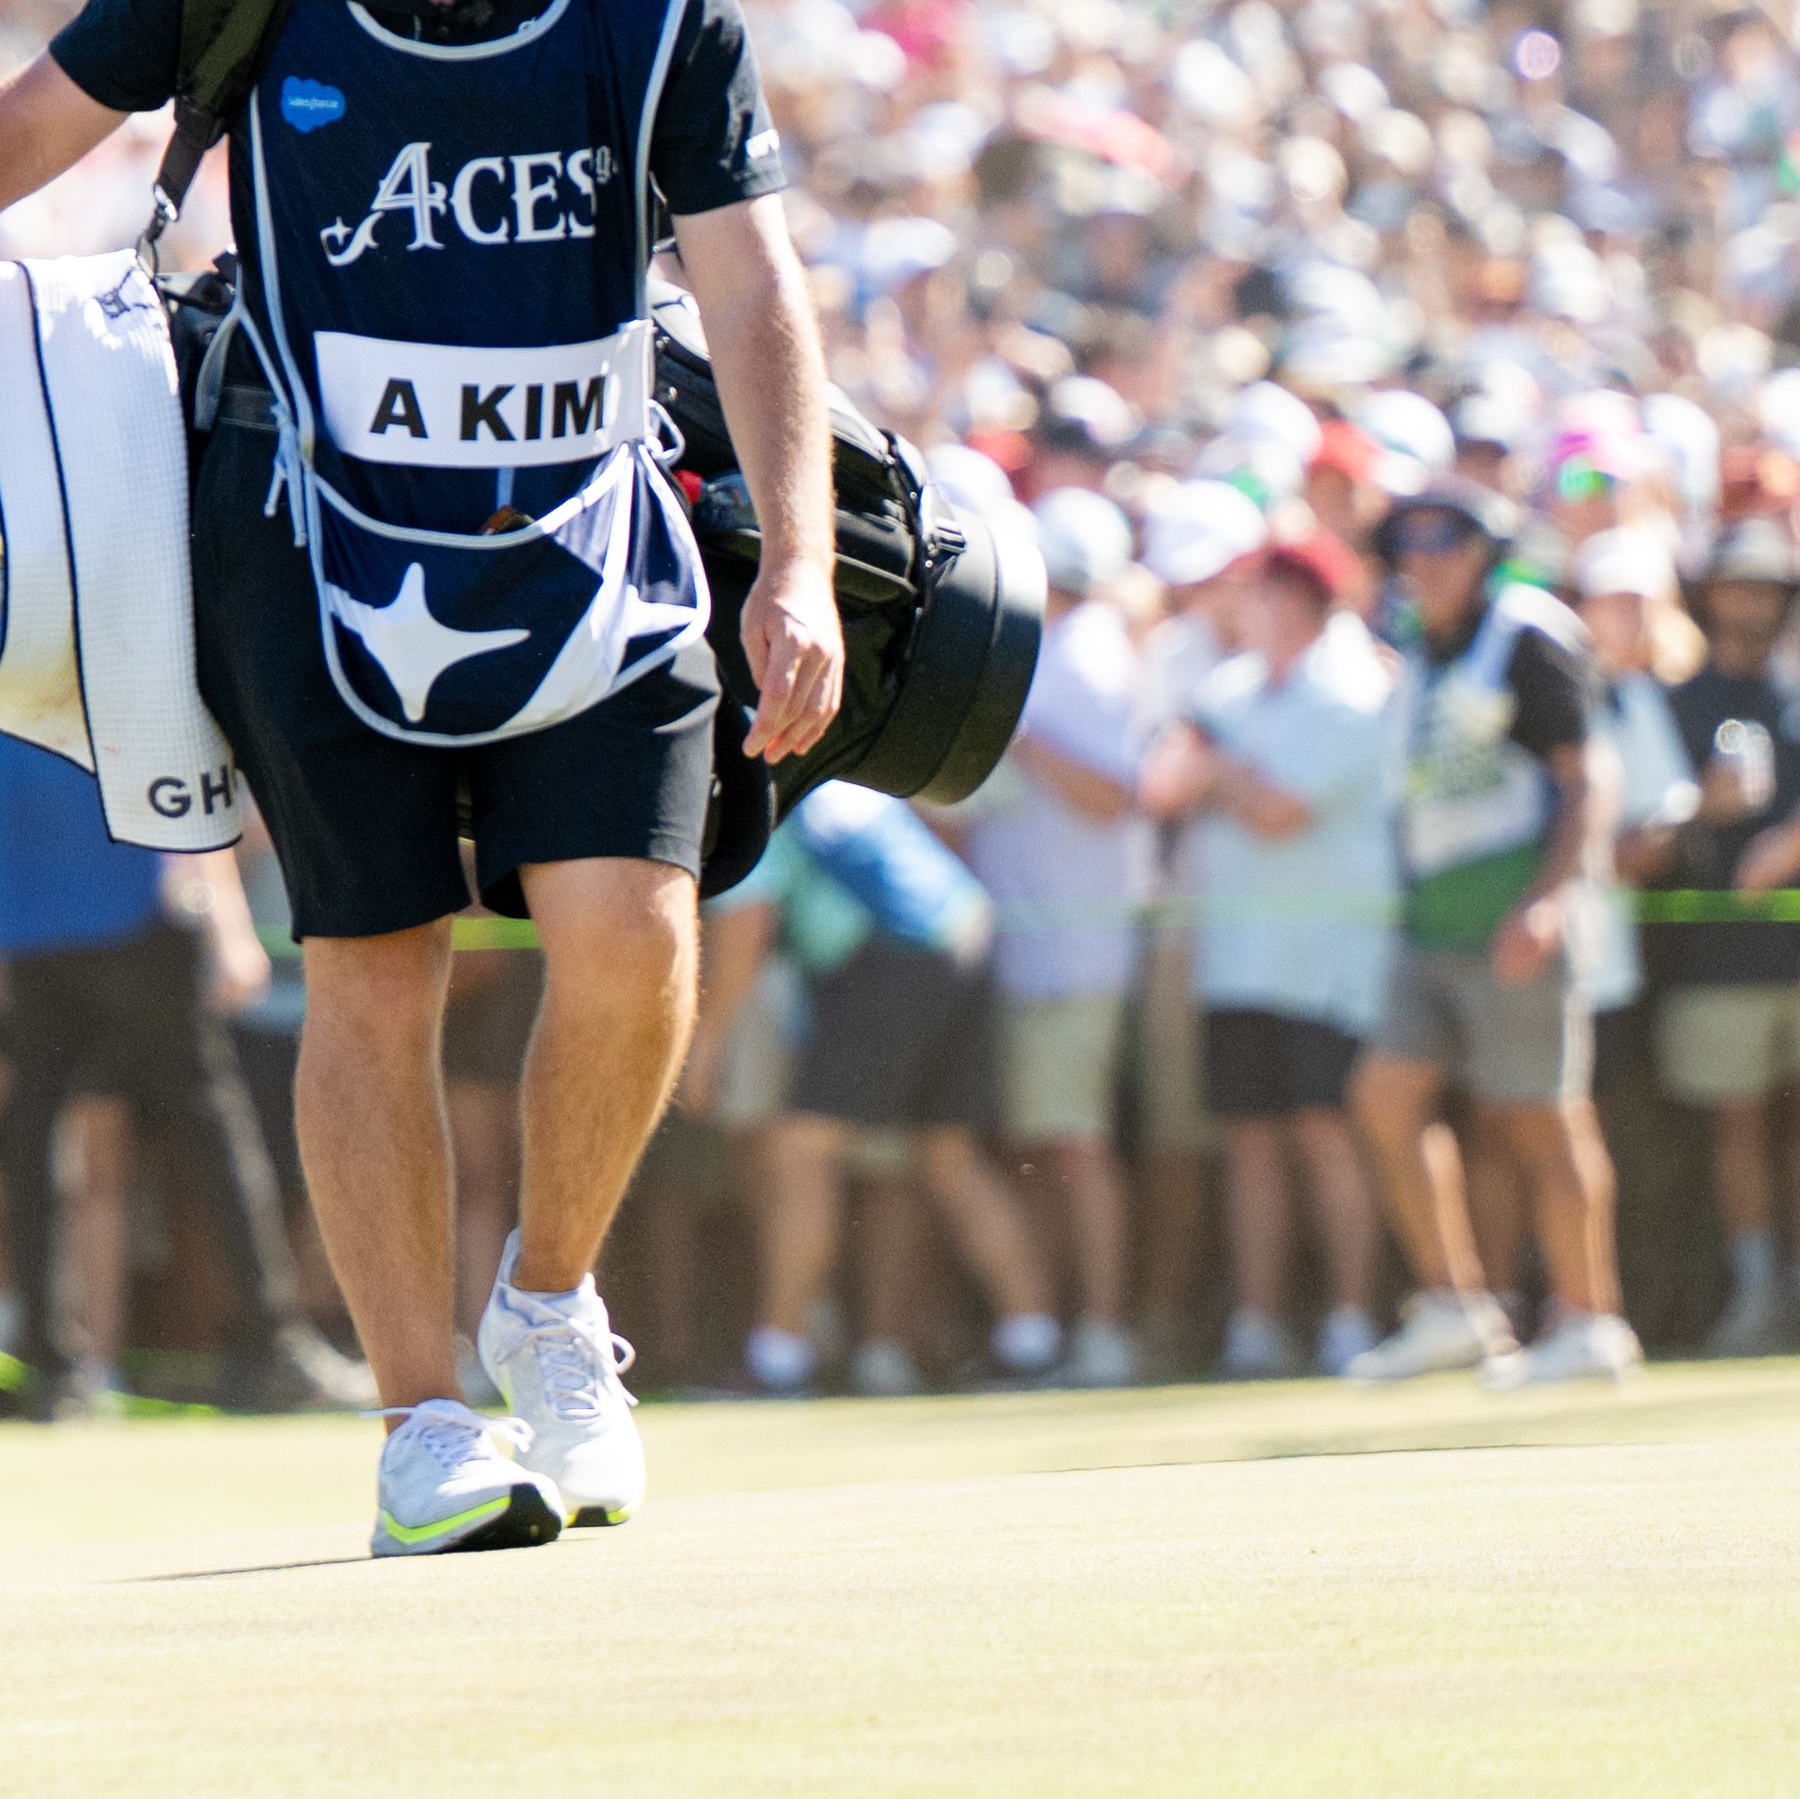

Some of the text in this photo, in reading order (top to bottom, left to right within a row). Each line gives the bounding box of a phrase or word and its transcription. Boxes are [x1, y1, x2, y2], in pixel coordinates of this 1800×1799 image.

[319, 141, 597, 267] ACES
[369, 374, 608, 442] A KIM
[147, 764, 237, 819] GH
